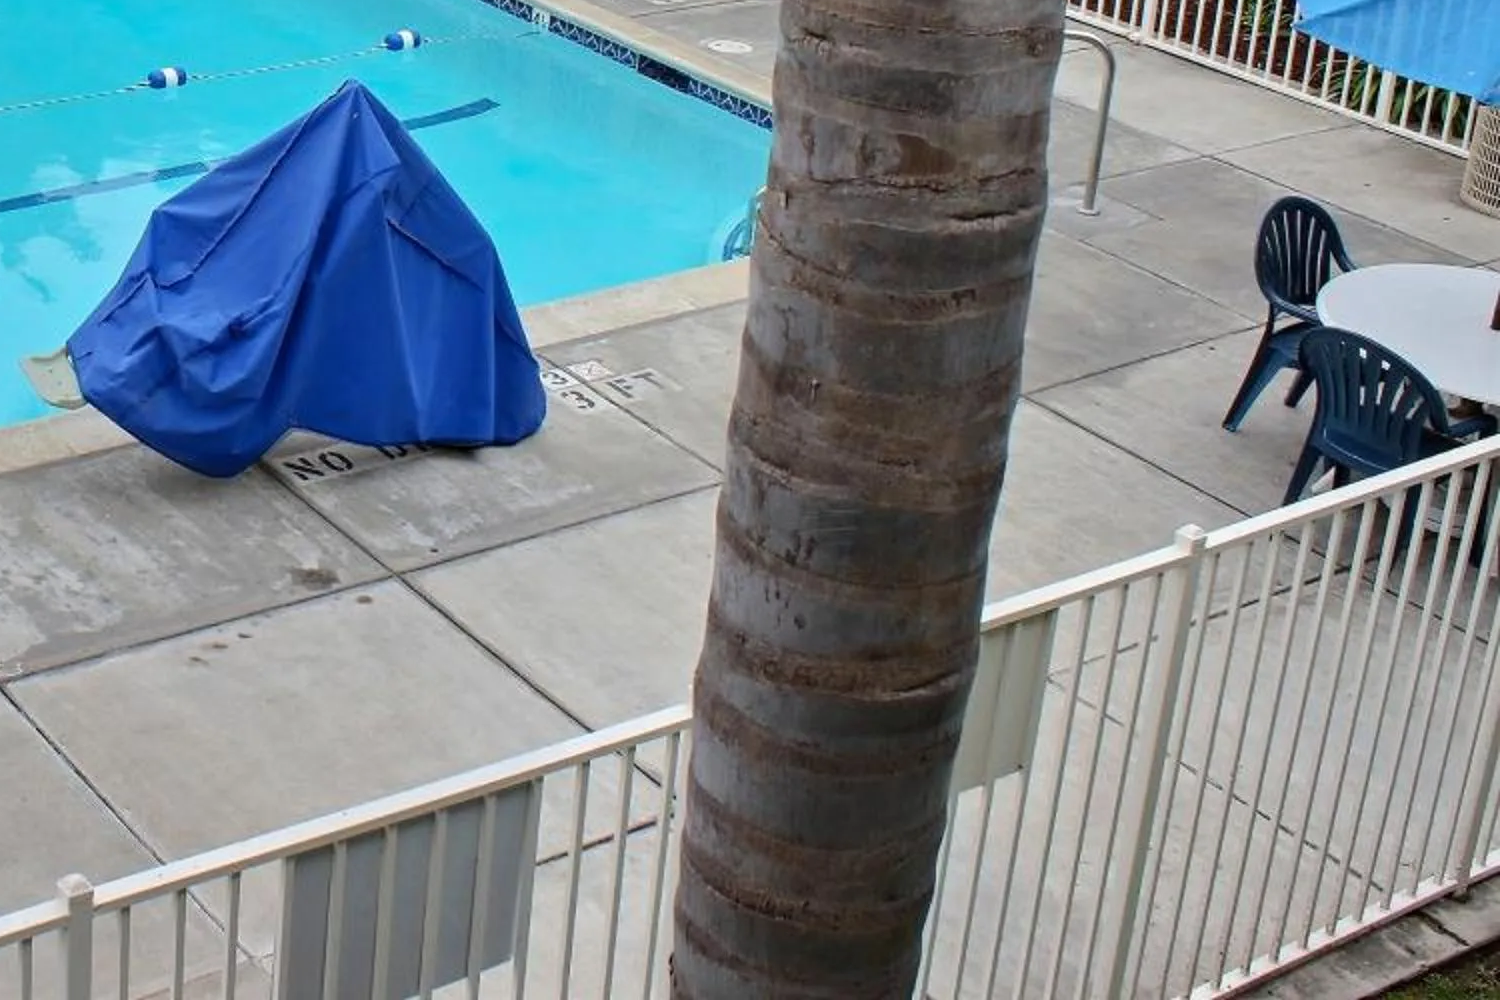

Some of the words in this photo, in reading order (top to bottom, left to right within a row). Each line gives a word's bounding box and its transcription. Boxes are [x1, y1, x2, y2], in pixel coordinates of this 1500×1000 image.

[561, 390, 596, 409] 3
[605, 371, 666, 399] FT
[283, 451, 355, 481] NO
